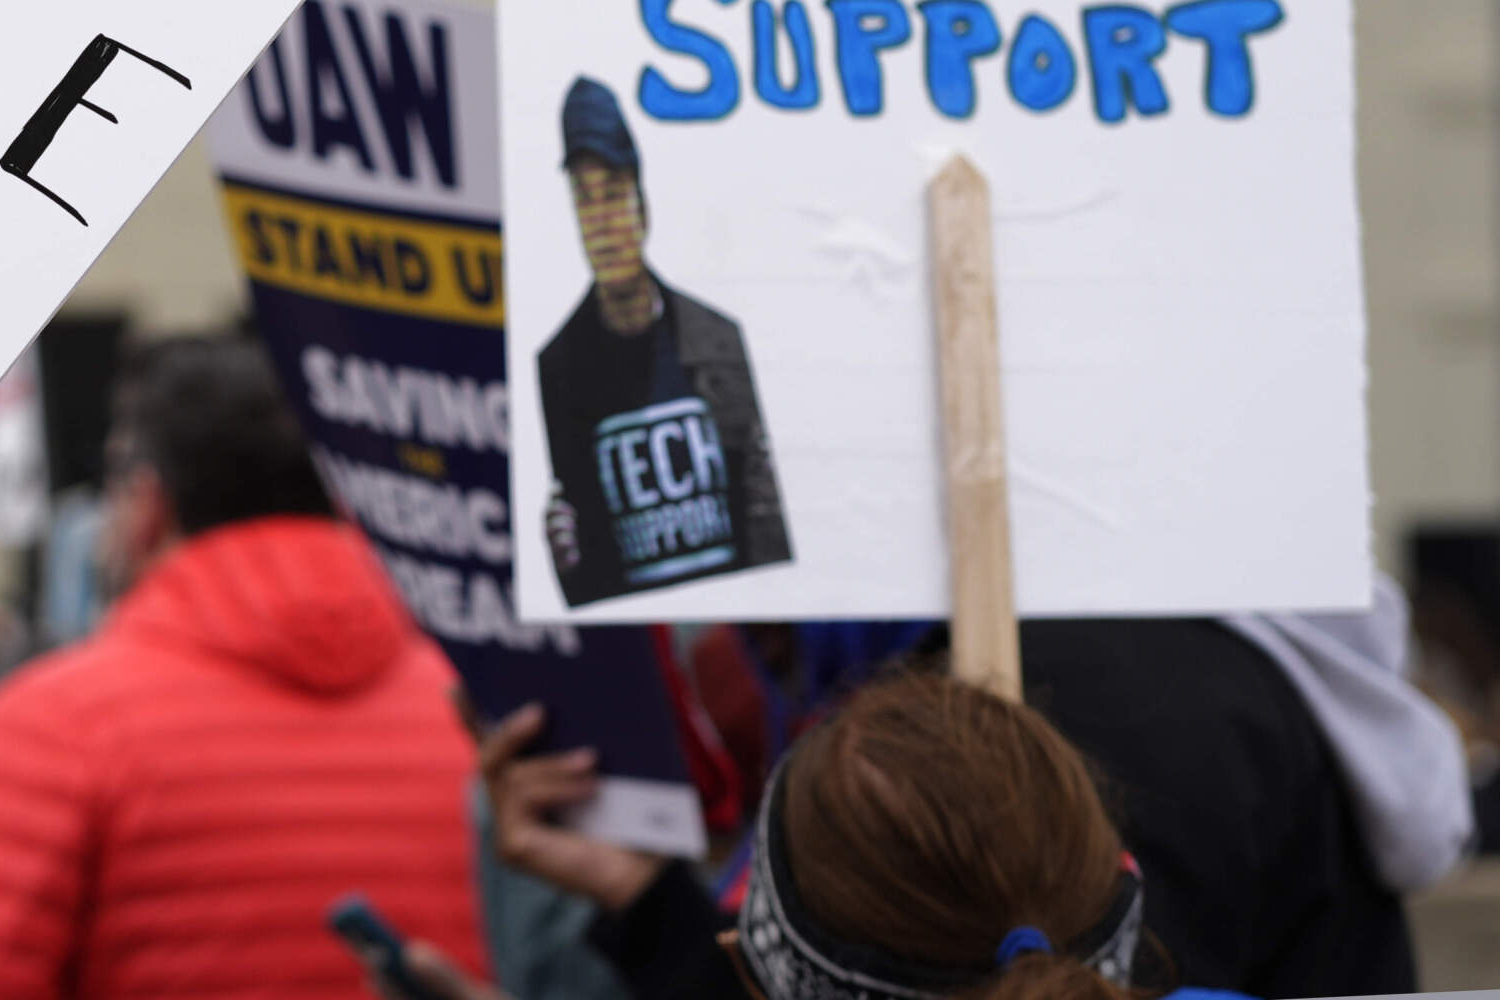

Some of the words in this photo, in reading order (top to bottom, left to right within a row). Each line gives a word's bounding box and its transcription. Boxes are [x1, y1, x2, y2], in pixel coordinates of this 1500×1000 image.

[247, 208, 432, 298] STAND
[452, 244, 503, 308] U
[597, 415, 729, 514] TECH
